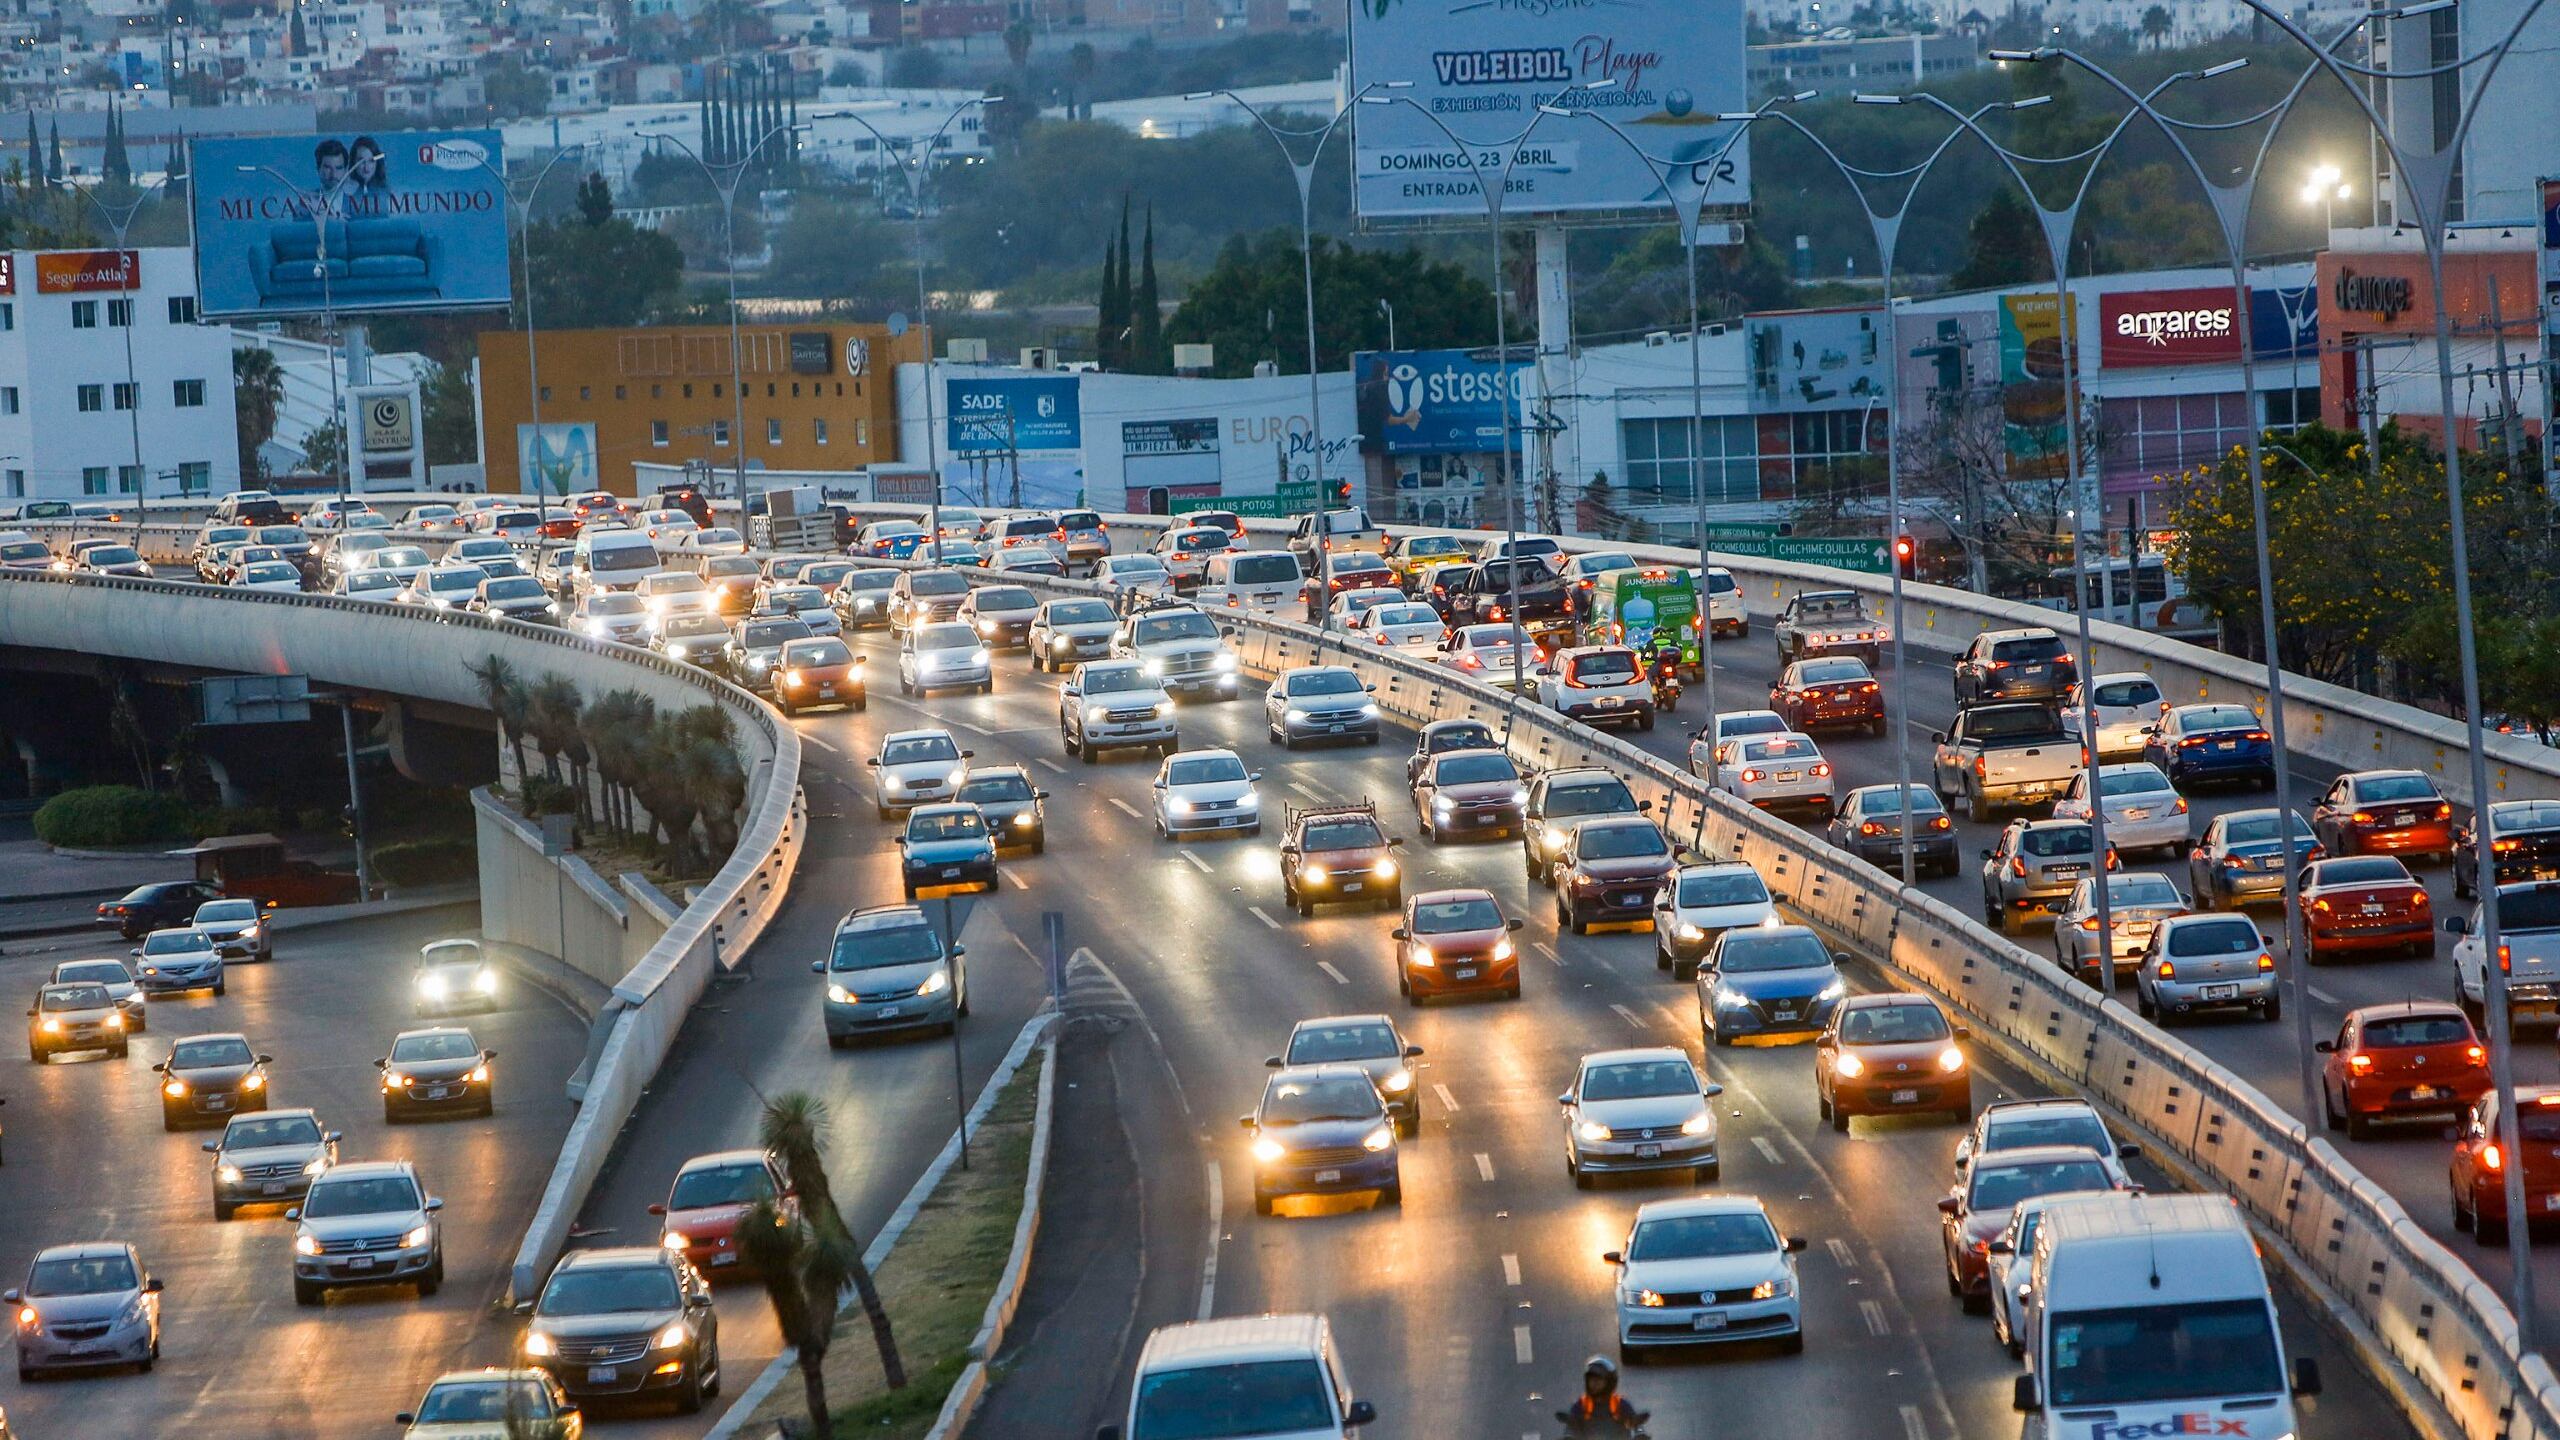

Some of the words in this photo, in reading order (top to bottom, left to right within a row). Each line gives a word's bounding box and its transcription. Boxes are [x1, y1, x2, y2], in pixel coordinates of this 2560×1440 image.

[1434, 49, 1571, 84] VOLEIBOL
[1573, 34, 1662, 92] Playa
[1432, 93, 1521, 113] EXHIBICIÓN
[1531, 89, 1657, 110] INTERNACIONAL
[1380, 153, 1470, 170] DOMINGO
[1479, 153, 1501, 167] 23
[1403, 182, 1479, 197] ENTRADA
[220, 198, 253, 220] MI
[349, 195, 381, 216] MI
[389, 189, 493, 214] MUNDO
[46, 271, 94, 288] Seguros
[2118, 308, 2232, 337] antares
[962, 394, 1004, 410] SADE
[1232, 415, 1310, 444] EURO
[1194, 503, 1213, 511] SAN
[1217, 501, 1238, 511] LUIS
[1711, 542, 1767, 553] CHICHIMEQUILLAS
[1779, 543, 1868, 555] CHICHIMEQUILLAS
[1846, 557, 1868, 568] Norte
[2091, 1410, 2251, 1440] FedEx
